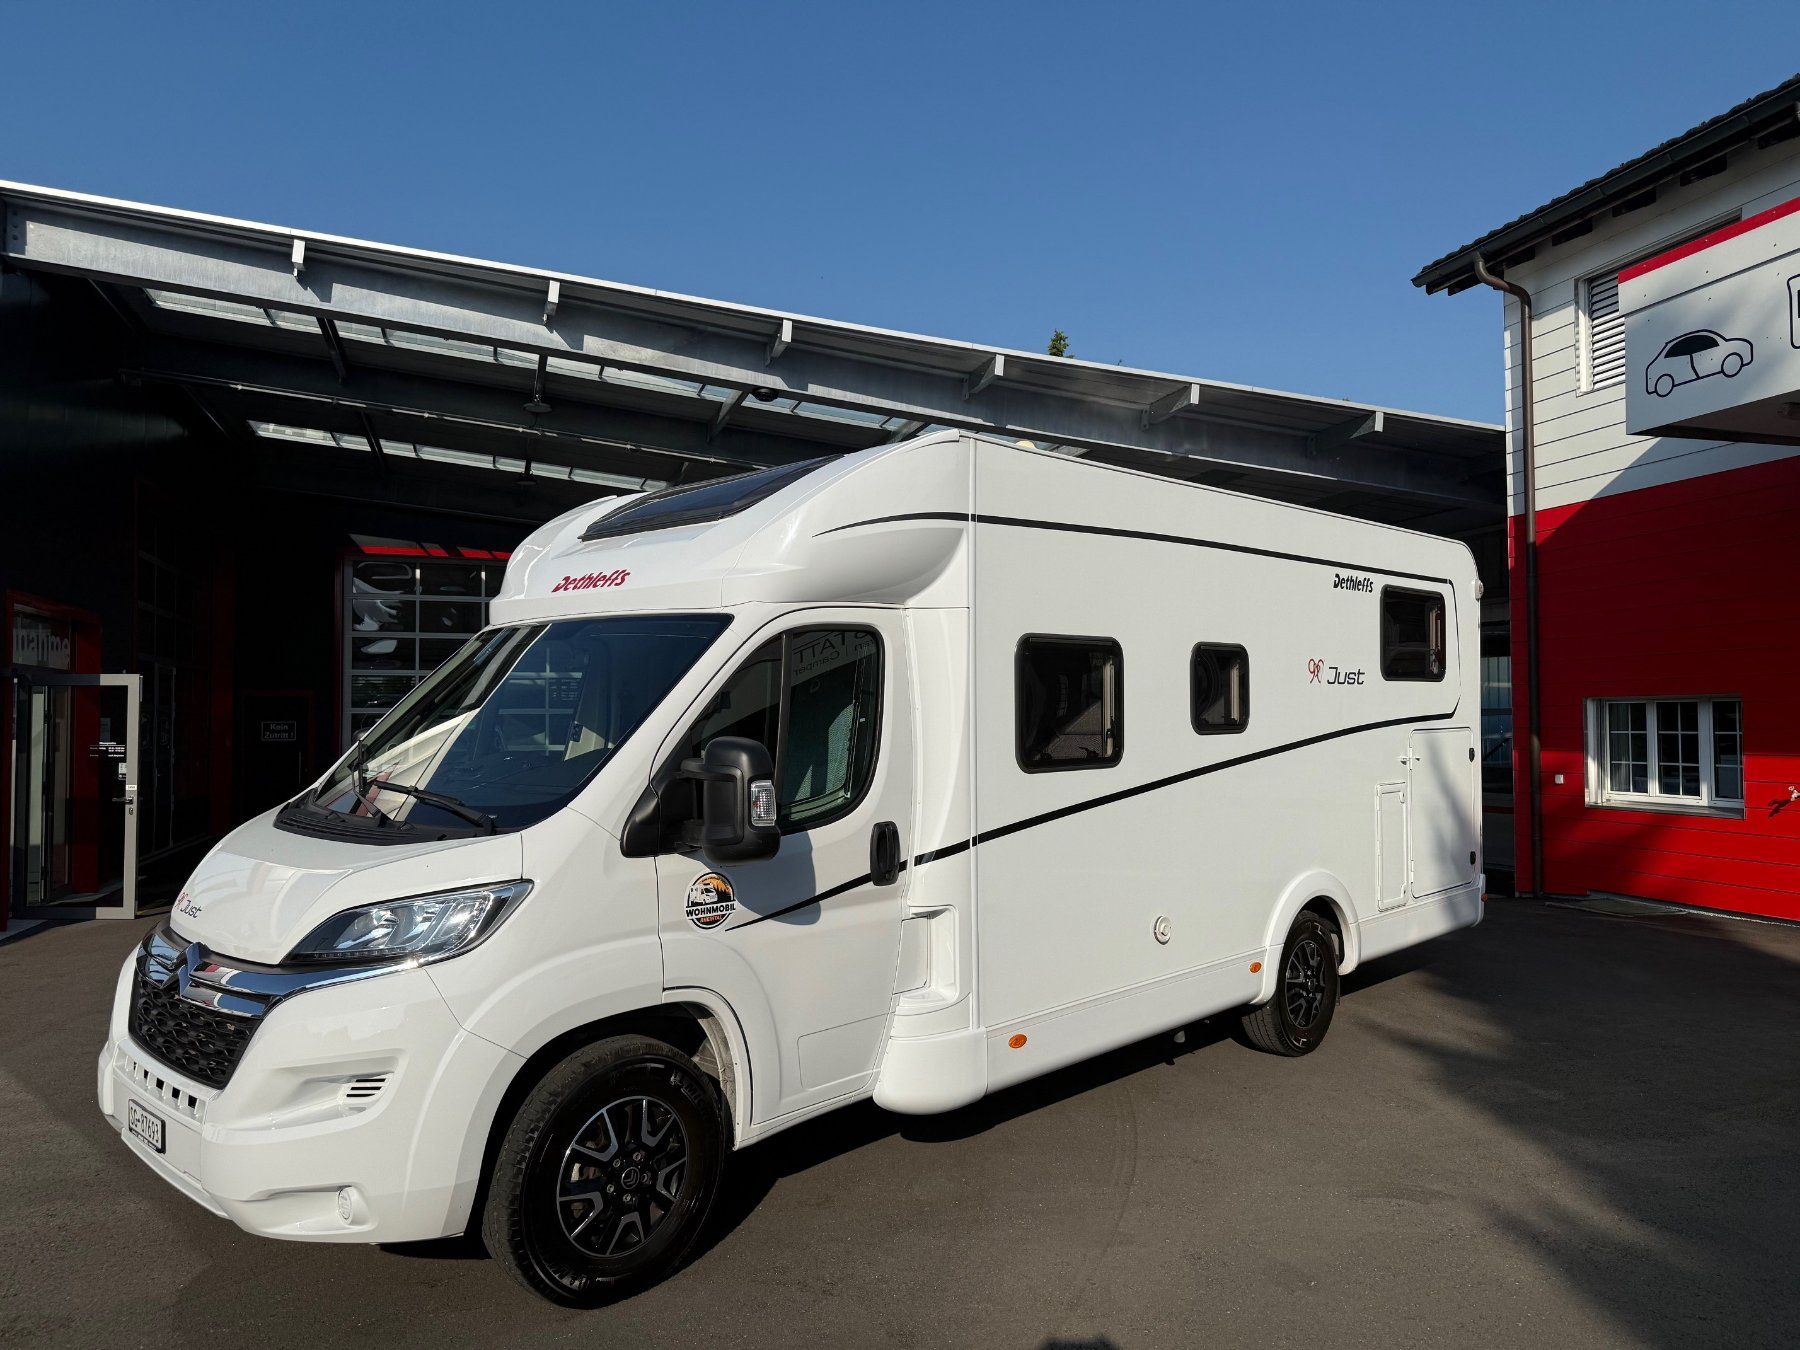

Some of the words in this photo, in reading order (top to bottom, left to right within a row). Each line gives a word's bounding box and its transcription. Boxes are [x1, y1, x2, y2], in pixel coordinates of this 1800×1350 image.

[551, 569, 631, 593] Dethleffs
[1333, 572, 1373, 593] Dethleffs
[1327, 666, 1365, 685] Just
[264, 731, 289, 739] Zutritt
[270, 723, 289, 731] Kein
[180, 899, 202, 919] Just
[686, 903, 736, 917] WOHNMOBIL
